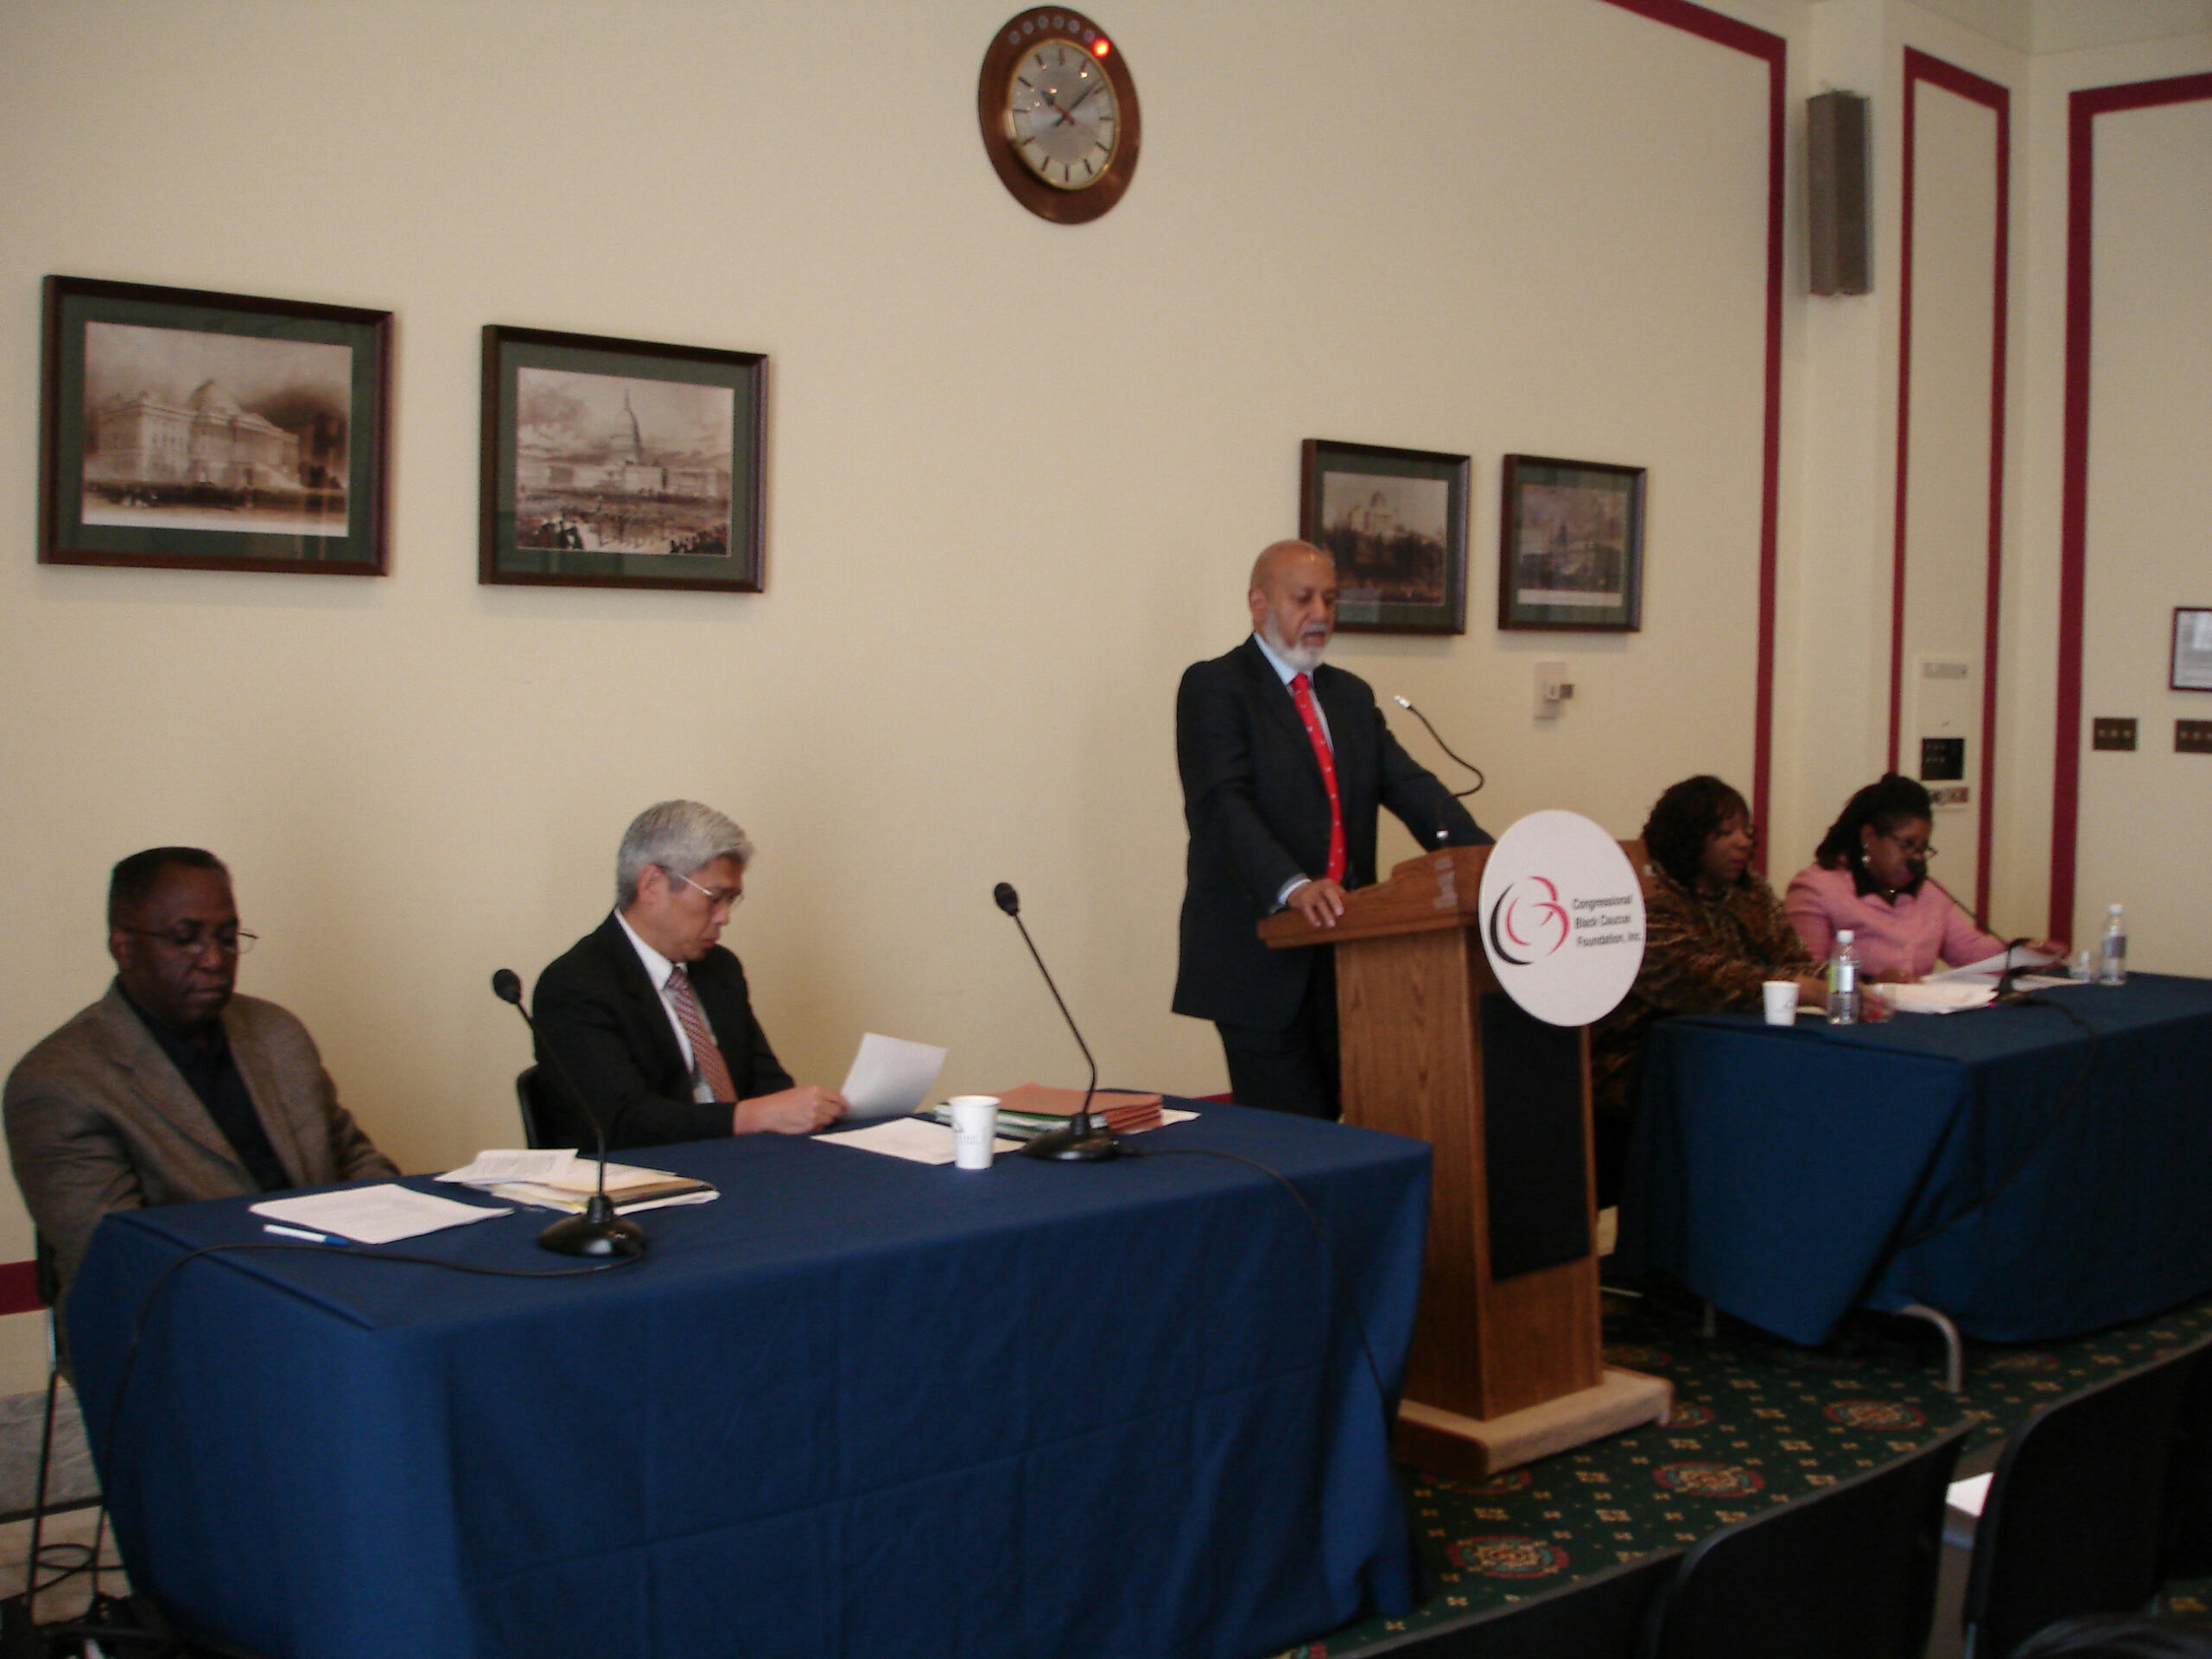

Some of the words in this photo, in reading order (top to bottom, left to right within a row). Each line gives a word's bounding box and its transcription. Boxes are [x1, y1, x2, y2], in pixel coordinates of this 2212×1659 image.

[1573, 894, 1632, 911] Congressional
[1575, 916, 1597, 929] Black
[1600, 914, 1631, 926] Caucus
